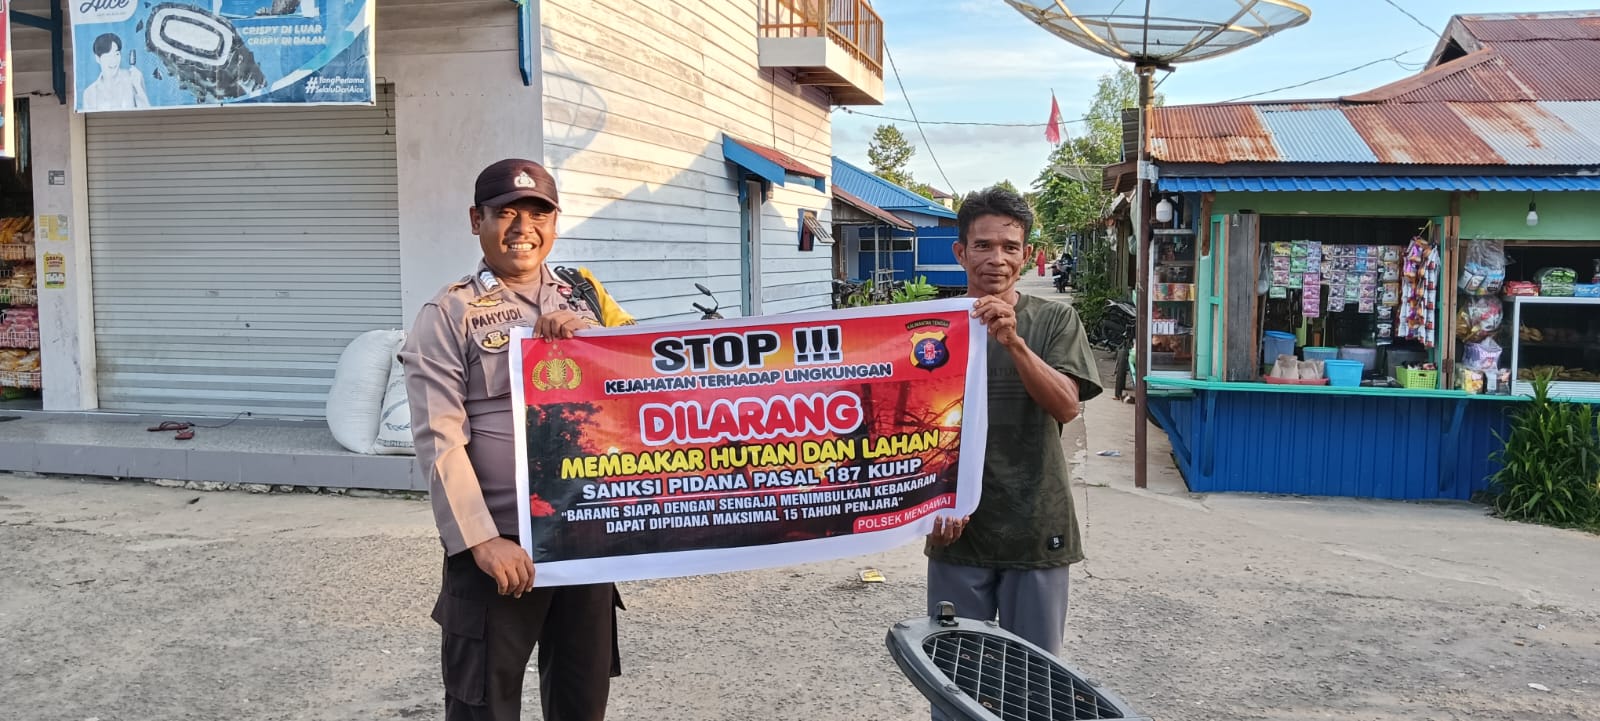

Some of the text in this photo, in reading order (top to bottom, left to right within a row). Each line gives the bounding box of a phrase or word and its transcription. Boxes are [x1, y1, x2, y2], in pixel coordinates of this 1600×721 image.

[243, 24, 322, 35] CRISPY DI LUAR
[247, 37, 279, 46] CRISPY
[281, 36, 292, 46] DI
[472, 308, 523, 329] PAHYUDI
[653, 326, 841, 373] STOP !!!
[605, 363, 892, 394] KEJAHATAN TERHADAP LINGKUNGAN
[640, 392, 862, 445] DILARANG
[560, 428, 940, 480] MEMBAKAR HUTAN DAN LAHAN
[582, 458, 923, 500] SANKSI PIDANA PASAL 187 KUHP
[623, 503, 661, 517] SIAPA
[664, 499, 716, 514] DENGAN
[719, 495, 777, 511] SENGAJA
[780, 487, 871, 506] MENIMBULKAN
[874, 473, 937, 496] KEBAKARAN
[606, 519, 647, 533] DAPAT
[649, 514, 710, 530] DIPIDANA
[712, 509, 780, 525] MAKSIMAL
[783, 508, 798, 521] 15
[801, 504, 841, 519] TAHUN
[857, 496, 951, 530] POLSEK MENDAWAI
